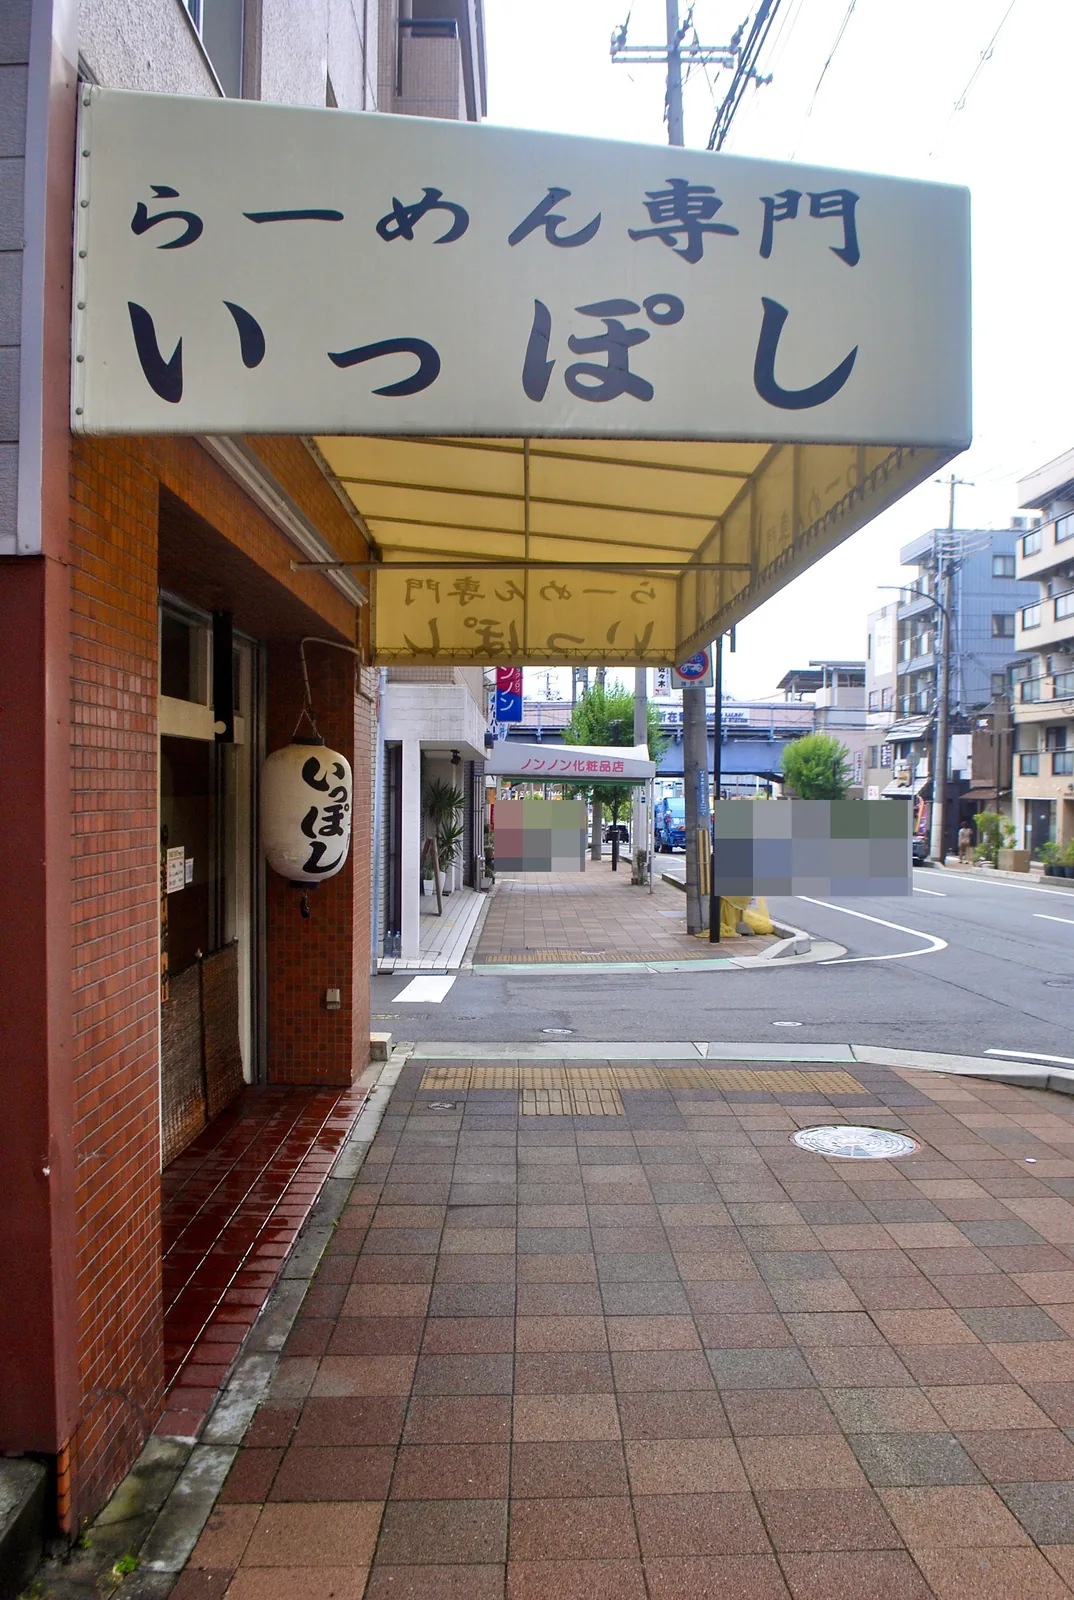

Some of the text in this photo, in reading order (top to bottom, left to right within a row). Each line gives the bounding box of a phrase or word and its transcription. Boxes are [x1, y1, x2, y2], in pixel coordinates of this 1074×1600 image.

[130, 178, 861, 268] らーめん専門
[127, 293, 859, 410] いっぽし
[301, 756, 350, 874] いっぽし
[521, 759, 624, 773] ノンノン化粧品店
